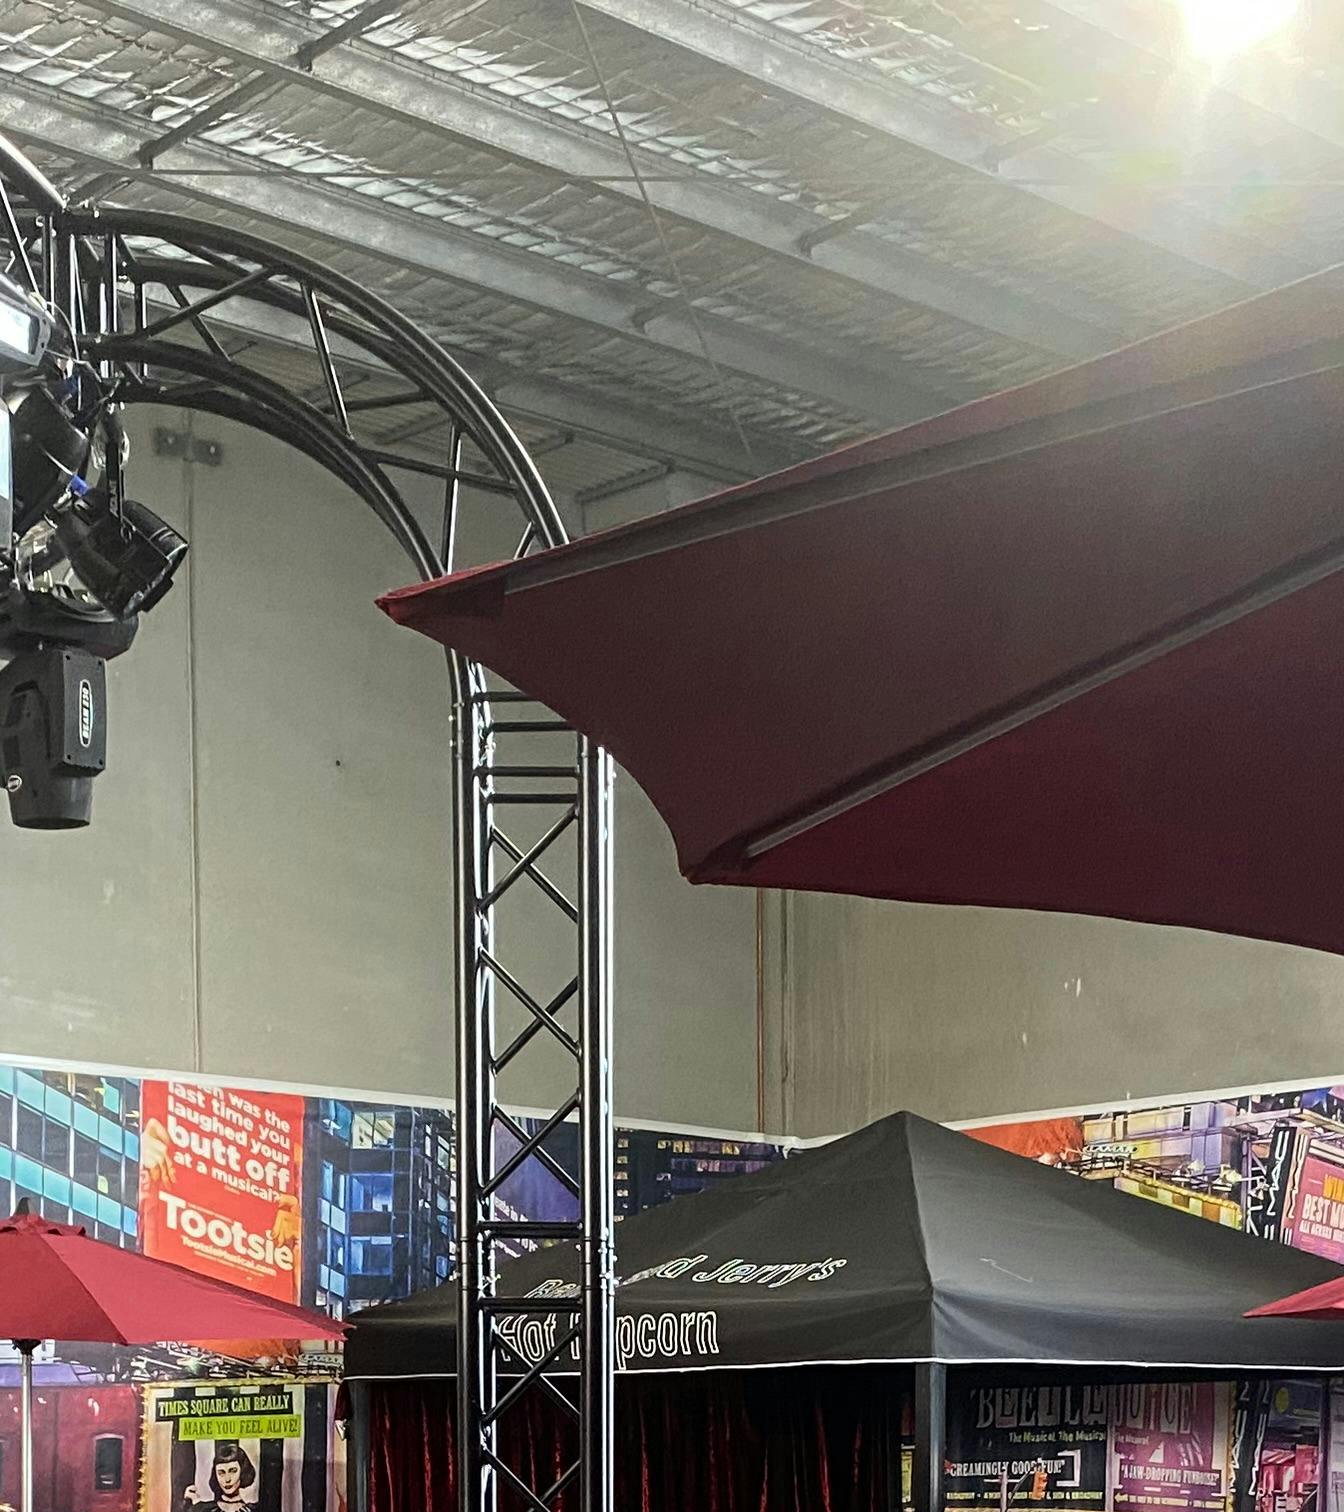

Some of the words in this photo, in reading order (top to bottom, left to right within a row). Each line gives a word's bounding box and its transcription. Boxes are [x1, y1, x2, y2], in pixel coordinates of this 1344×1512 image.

[168, 1082, 205, 1108] last
[211, 1098, 254, 1131] time
[258, 1124, 290, 1149] you
[168, 1095, 248, 1147] laughed
[250, 1138, 290, 1165] your
[229, 1093, 261, 1118] was
[265, 1109, 291, 1133] the
[167, 1115, 241, 1172] butt
[245, 1159, 290, 1192] off
[173, 1151, 192, 1169] at
[196, 1161, 208, 1174] a
[1302, 1194, 1331, 1224] BEST
[158, 1190, 294, 1271] Tootsie
[692, 1258, 848, 1288] Jerry's
[499, 1312, 559, 1361] Hot
[570, 1311, 720, 1371] pcorn
[158, 1399, 189, 1417] TIMES
[190, 1398, 229, 1417] SQUARE
[231, 1397, 251, 1413] CAN
[253, 1394, 290, 1412] REALLY
[184, 1421, 213, 1436] MAKE
[216, 1421, 237, 1435] YOU
[240, 1420, 264, 1435] FEEL
[267, 1418, 298, 1434] ALIVE!
[949, 1460, 1009, 1477] CREAMINGLY
